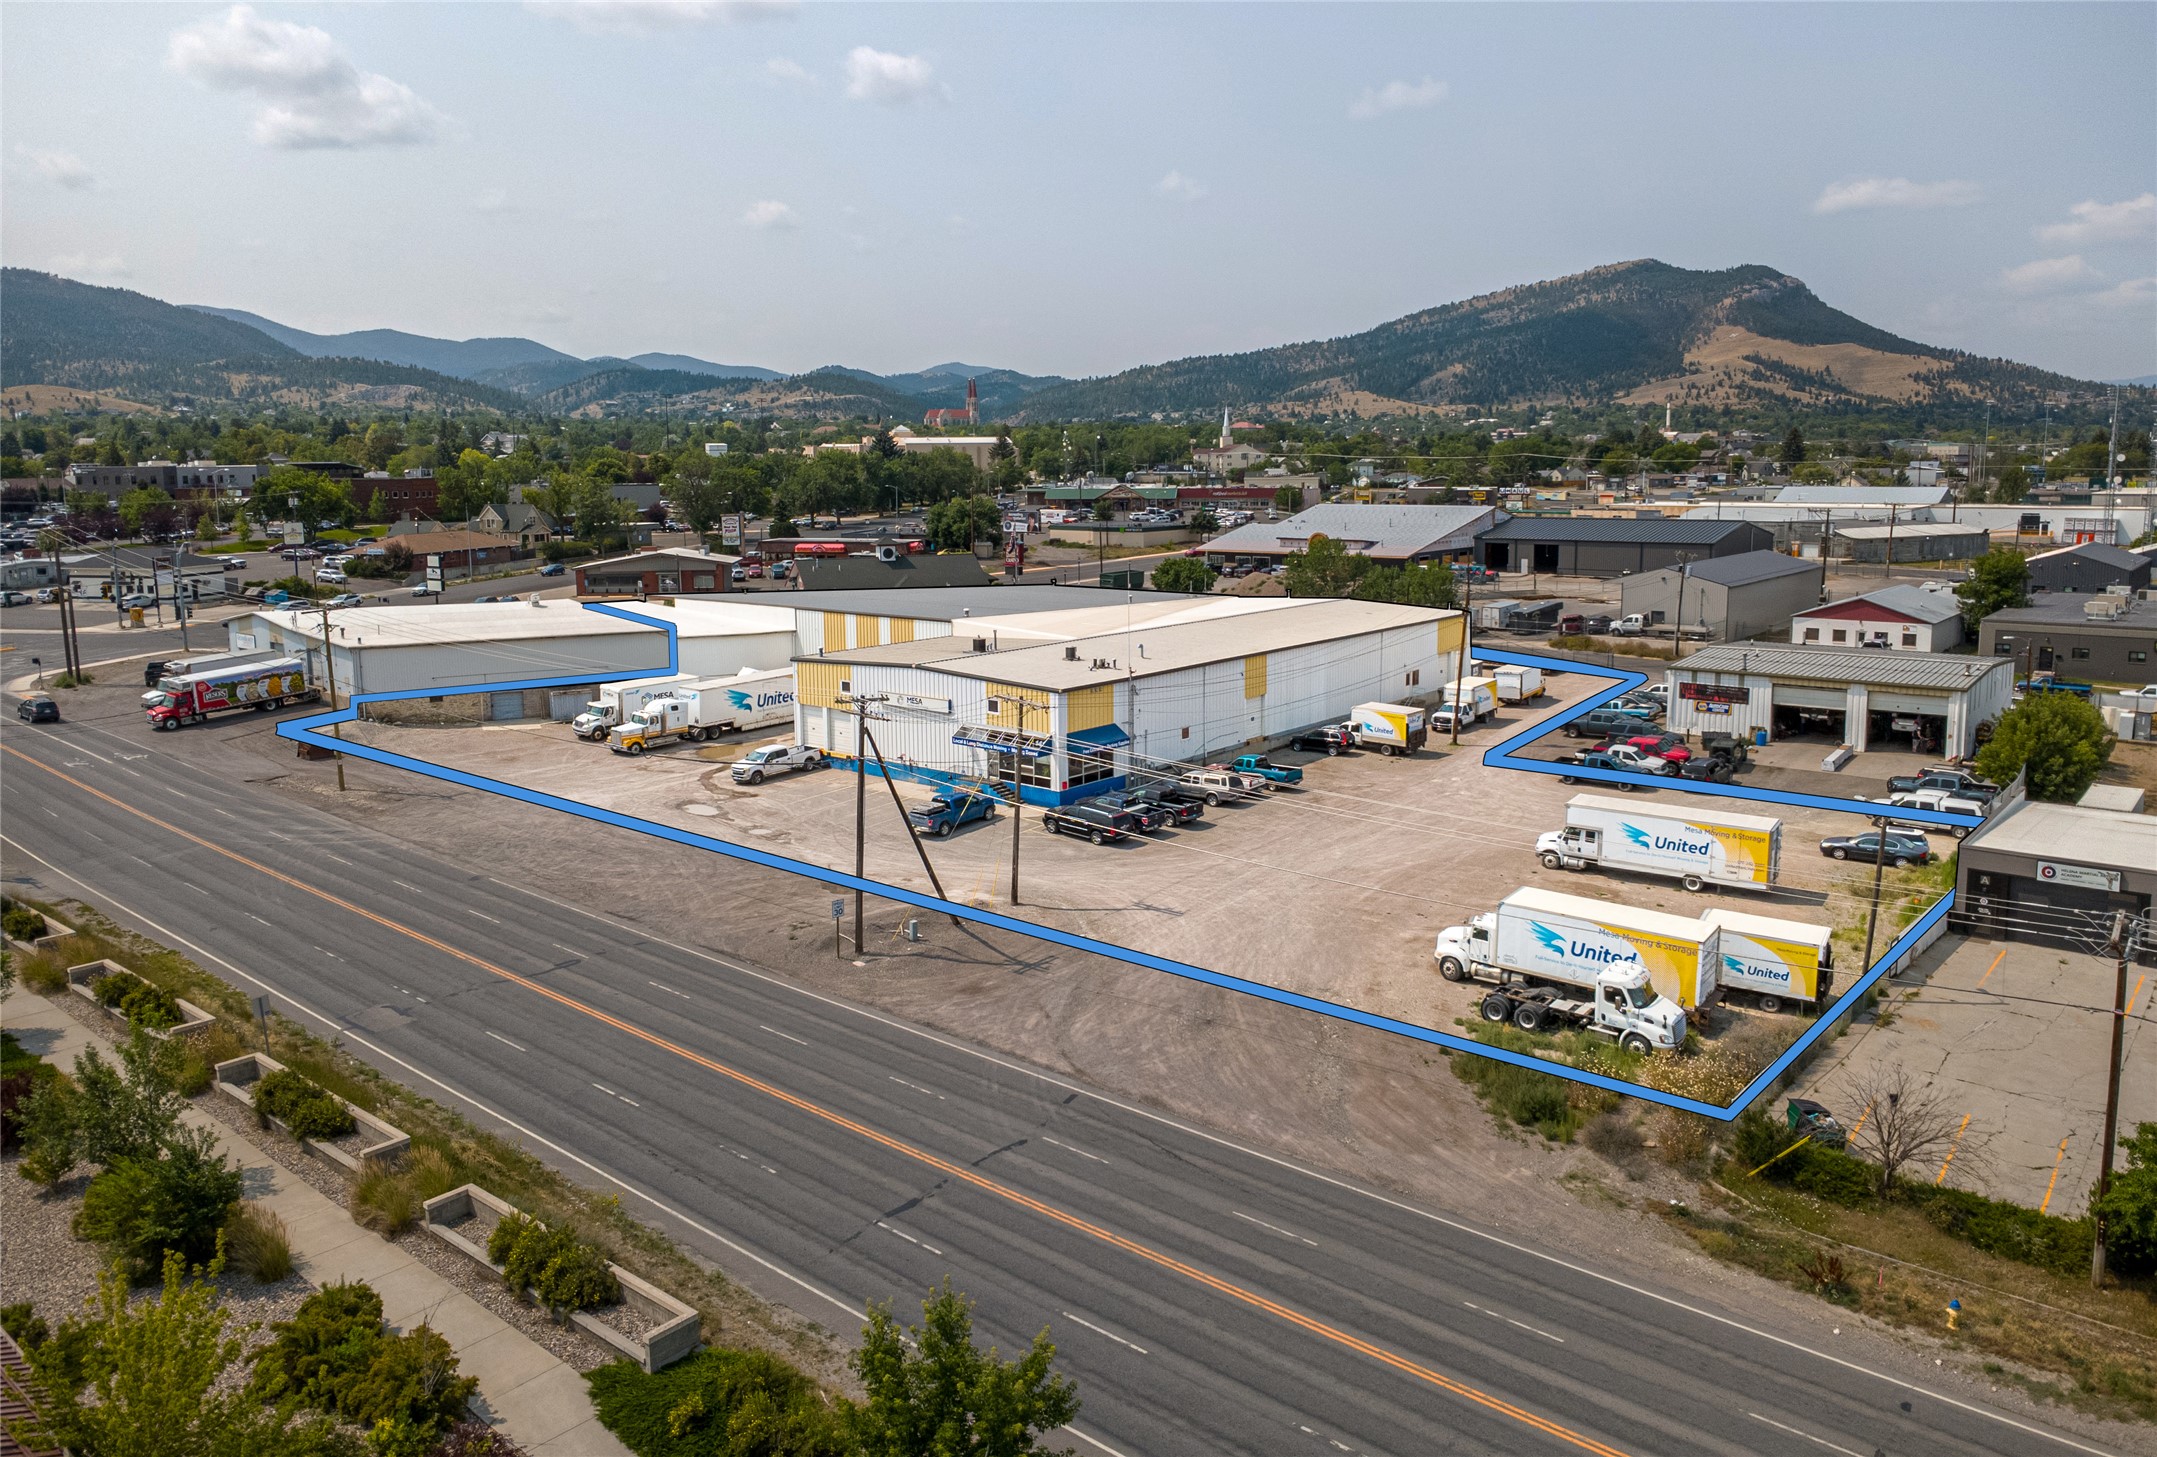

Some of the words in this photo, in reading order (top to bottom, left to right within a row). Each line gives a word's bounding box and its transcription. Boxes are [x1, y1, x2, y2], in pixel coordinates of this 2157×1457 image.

[1374, 726, 1394, 735] United
[1684, 826, 1703, 835] Mesa
[1704, 828, 1730, 840] Moving
[1738, 833, 1766, 844] Storage
[1655, 836, 1710, 856] United
[1981, 876, 1990, 885] A
[834, 908, 843, 916] 30
[1598, 928, 1620, 940] Mesa
[1622, 933, 1653, 948] Moving
[1655, 940, 1662, 948] &
[1663, 942, 1698, 957] Storage
[1571, 940, 1638, 964] United
[1747, 965, 1790, 982] United
